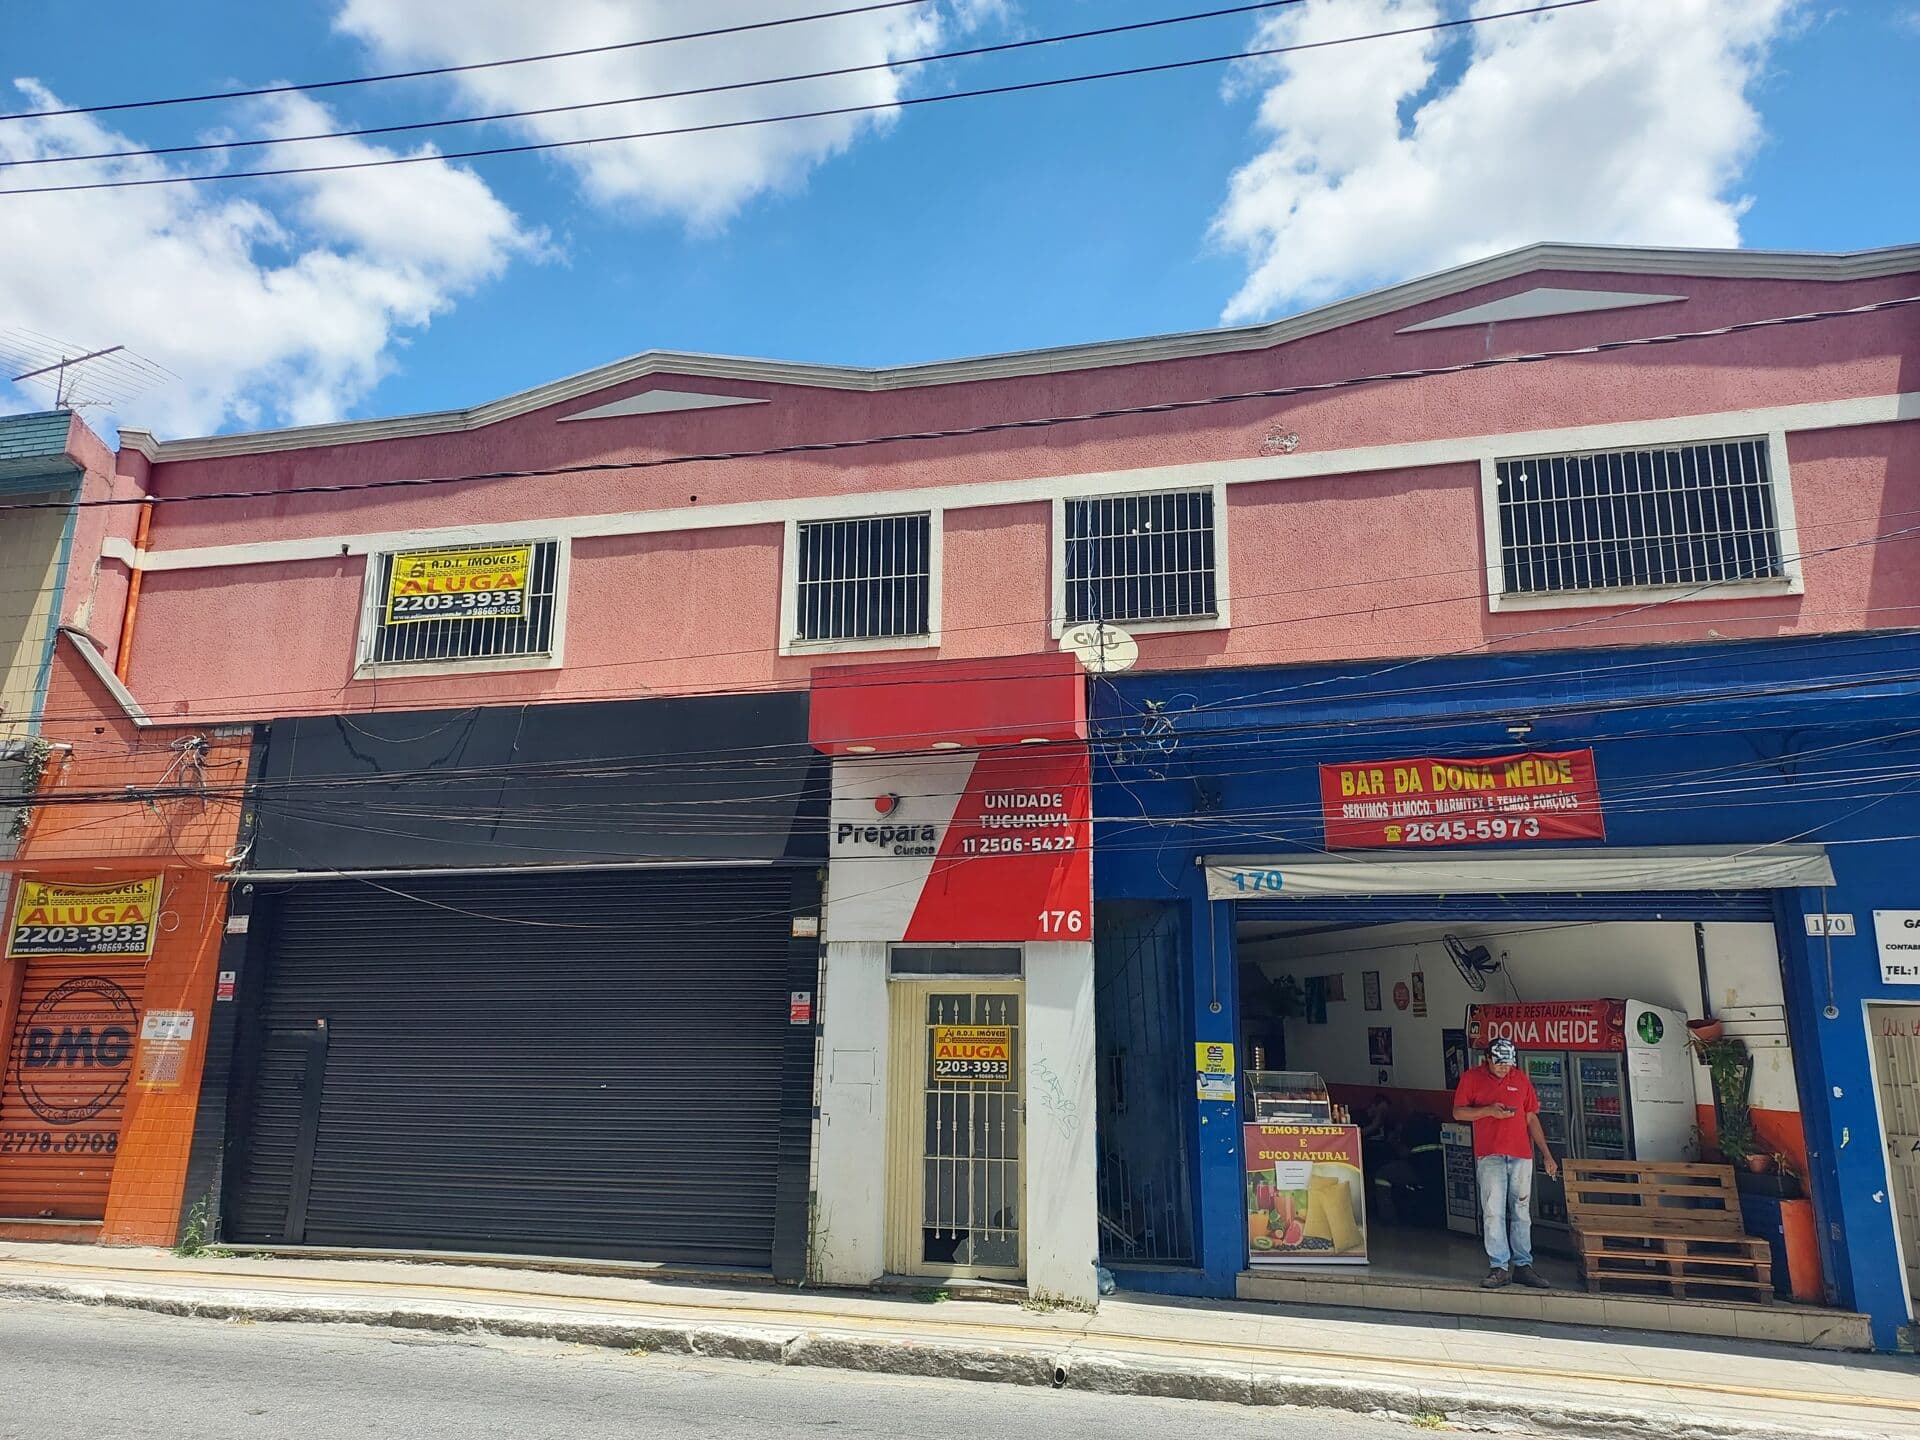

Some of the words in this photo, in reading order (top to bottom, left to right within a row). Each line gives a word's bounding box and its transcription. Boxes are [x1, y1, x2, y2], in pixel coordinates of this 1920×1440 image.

[400, 573, 518, 594] ALUGA
[394, 591, 521, 611] 2203-3933
[1341, 769, 1385, 796] BAR
[1395, 767, 1423, 793] DA
[1432, 764, 1495, 791] DONA
[1505, 760, 1573, 787] NEIDE
[984, 793, 1062, 808] UNIDADE
[1342, 801, 1388, 819] SERVIMOS
[1436, 796, 1485, 816] MARMITEX
[1487, 796, 1494, 811] E
[1497, 794, 1530, 812] TEMOS
[979, 813, 1069, 828] TUCURUVI
[838, 824, 935, 847] Prepara
[1406, 818, 1540, 842] 2645-5973
[894, 844, 935, 855] Cursos
[962, 838, 975, 852] 11
[980, 837, 1075, 853] 2506-5422
[1232, 870, 1284, 892] 170
[23, 905, 144, 924] ALUGA
[1038, 911, 1082, 933] 176
[15, 925, 147, 943] 2203-3933
[1813, 919, 1846, 932] 170
[96, 943, 144, 952] 98669-5663
[1495, 1006, 1515, 1018] BAR
[1516, 1006, 1522, 1017] E
[1526, 1004, 1593, 1018] RESTAURANTE
[1488, 1021, 1539, 1043] DONA
[1545, 1020, 1598, 1043] NEIDE
[24, 1027, 130, 1068] BMG
[938, 1045, 1006, 1058] ALUGA
[936, 1061, 1008, 1073] 2203-3933
[1260, 1126, 1299, 1135] TEMOS
[1302, 1126, 1345, 1135] PASTEL
[1299, 1138, 1308, 1148] E
[1258, 1151, 1291, 1160] SUCO
[1293, 1151, 1349, 1161] NATURAL
